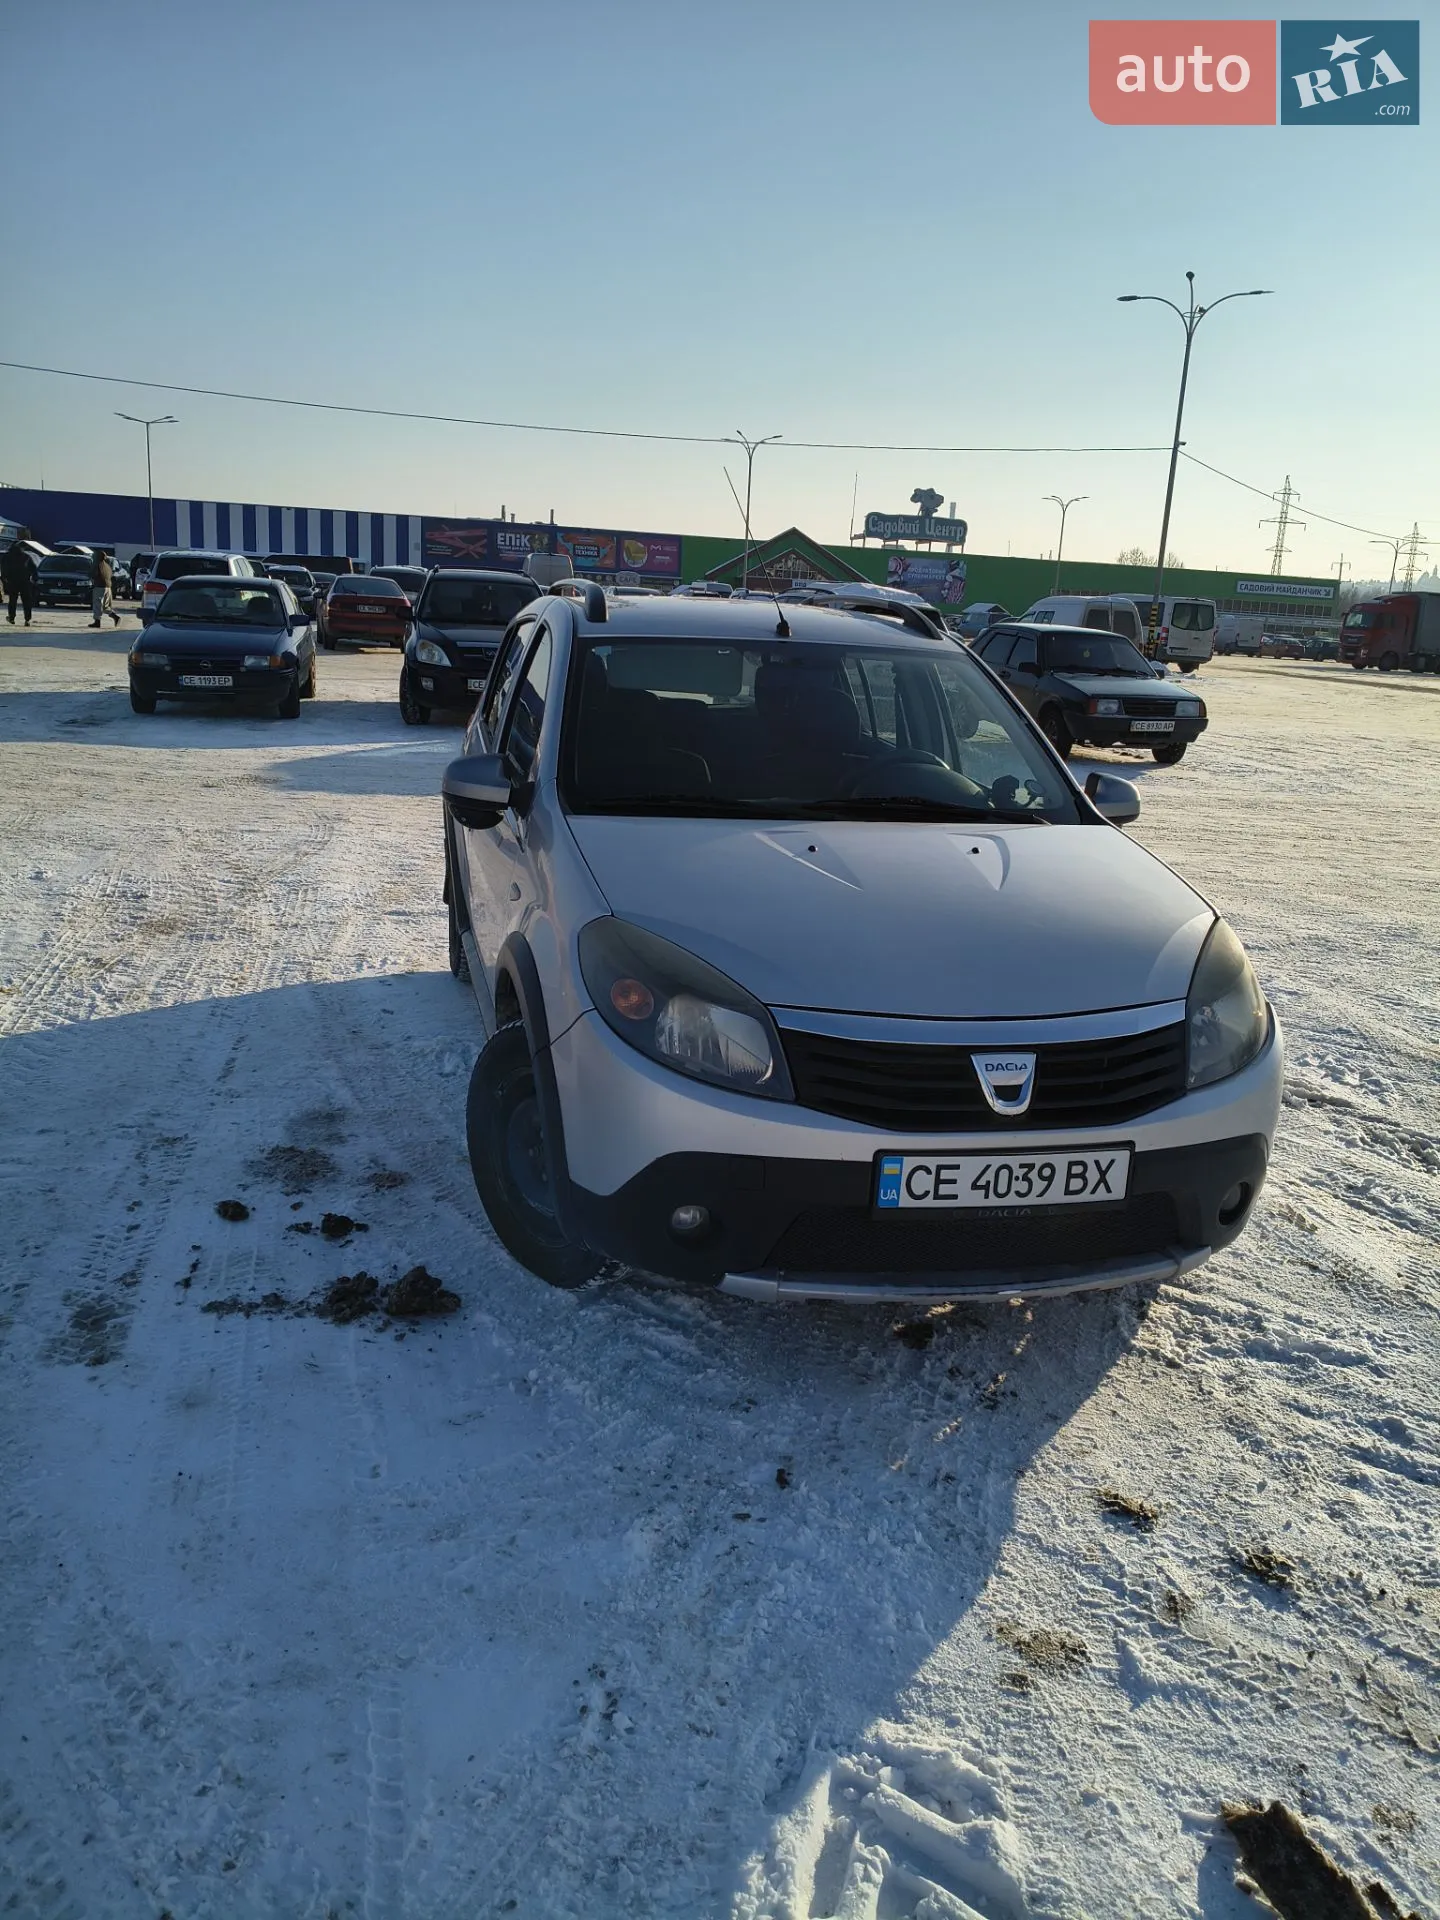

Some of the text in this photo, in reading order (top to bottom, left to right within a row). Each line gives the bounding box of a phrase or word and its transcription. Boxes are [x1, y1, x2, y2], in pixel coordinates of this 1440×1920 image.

[868, 515, 964, 541] Садовий Центр
[1239, 583, 1322, 596] САДОВИЙ МАЙДАНЧИК
[183, 676, 231, 686] CE 1193 EP
[1135, 722, 1146, 730] CE
[1162, 722, 1174, 730] AP
[984, 1062, 1028, 1072] DACIA
[905, 1158, 1116, 1200] CE 4039 BX
[880, 1189, 898, 1201] UA
